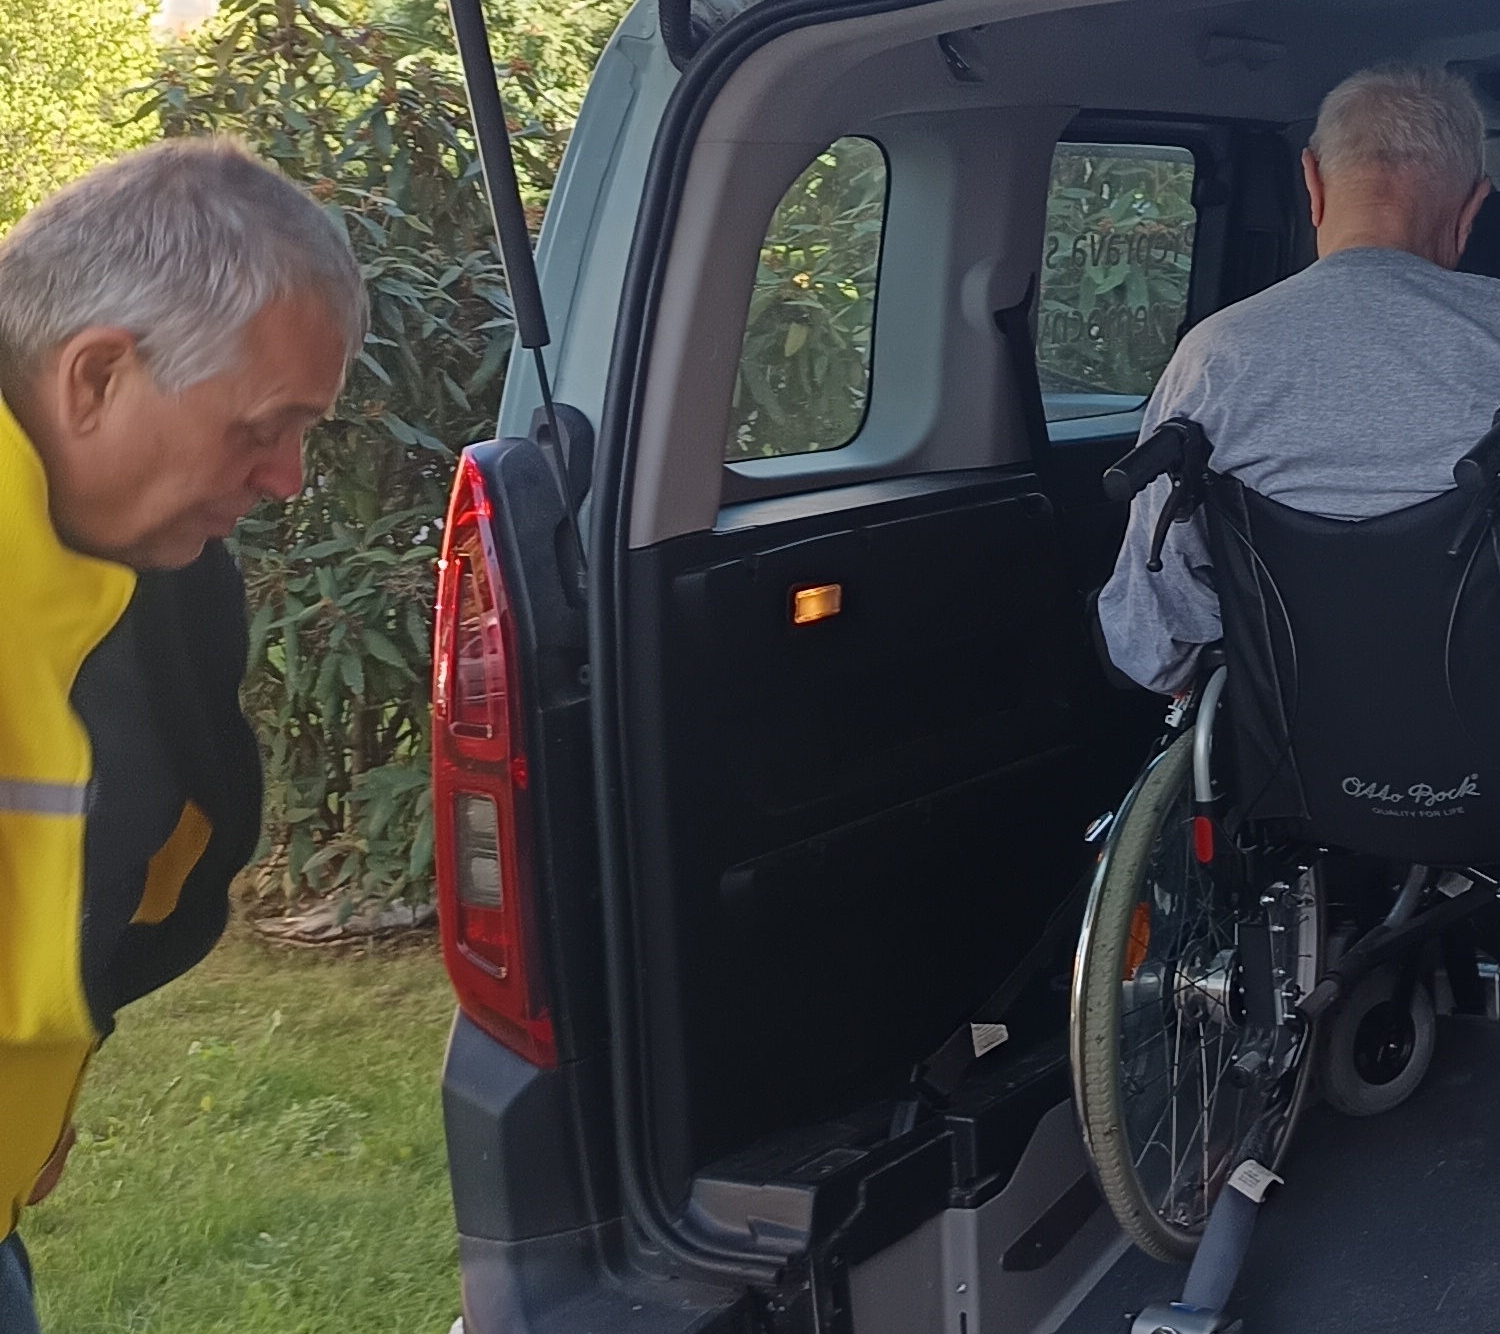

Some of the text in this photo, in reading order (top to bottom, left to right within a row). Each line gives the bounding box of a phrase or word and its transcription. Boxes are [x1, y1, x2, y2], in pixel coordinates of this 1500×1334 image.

[1342, 775, 1481, 806] Otto Bock
[1371, 806, 1465, 817] QUALITY FOR LIFE
